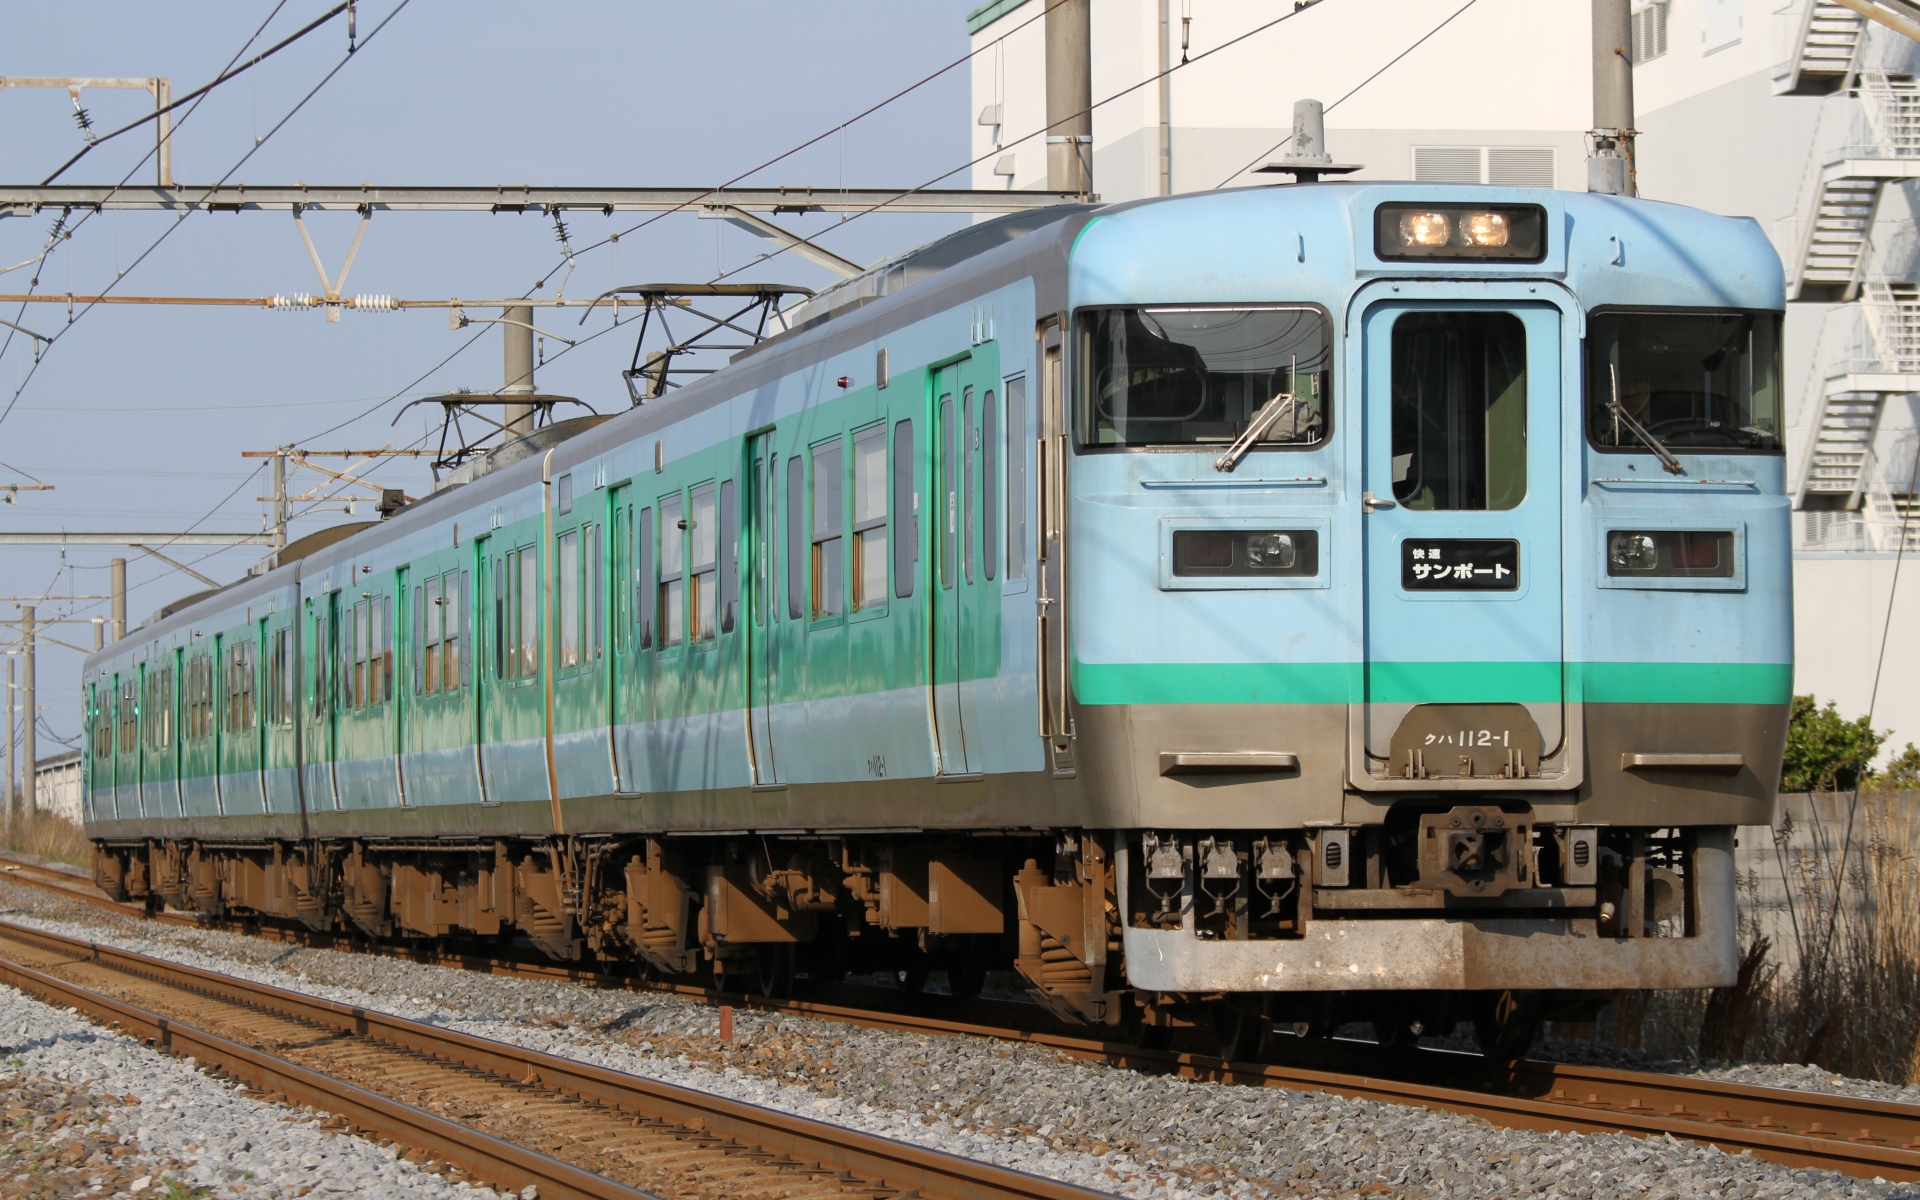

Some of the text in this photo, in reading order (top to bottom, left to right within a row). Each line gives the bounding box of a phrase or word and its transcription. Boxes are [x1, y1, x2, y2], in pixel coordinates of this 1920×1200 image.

[1412, 548, 1441, 560] 快速
[1412, 562, 1511, 580] サンポート
